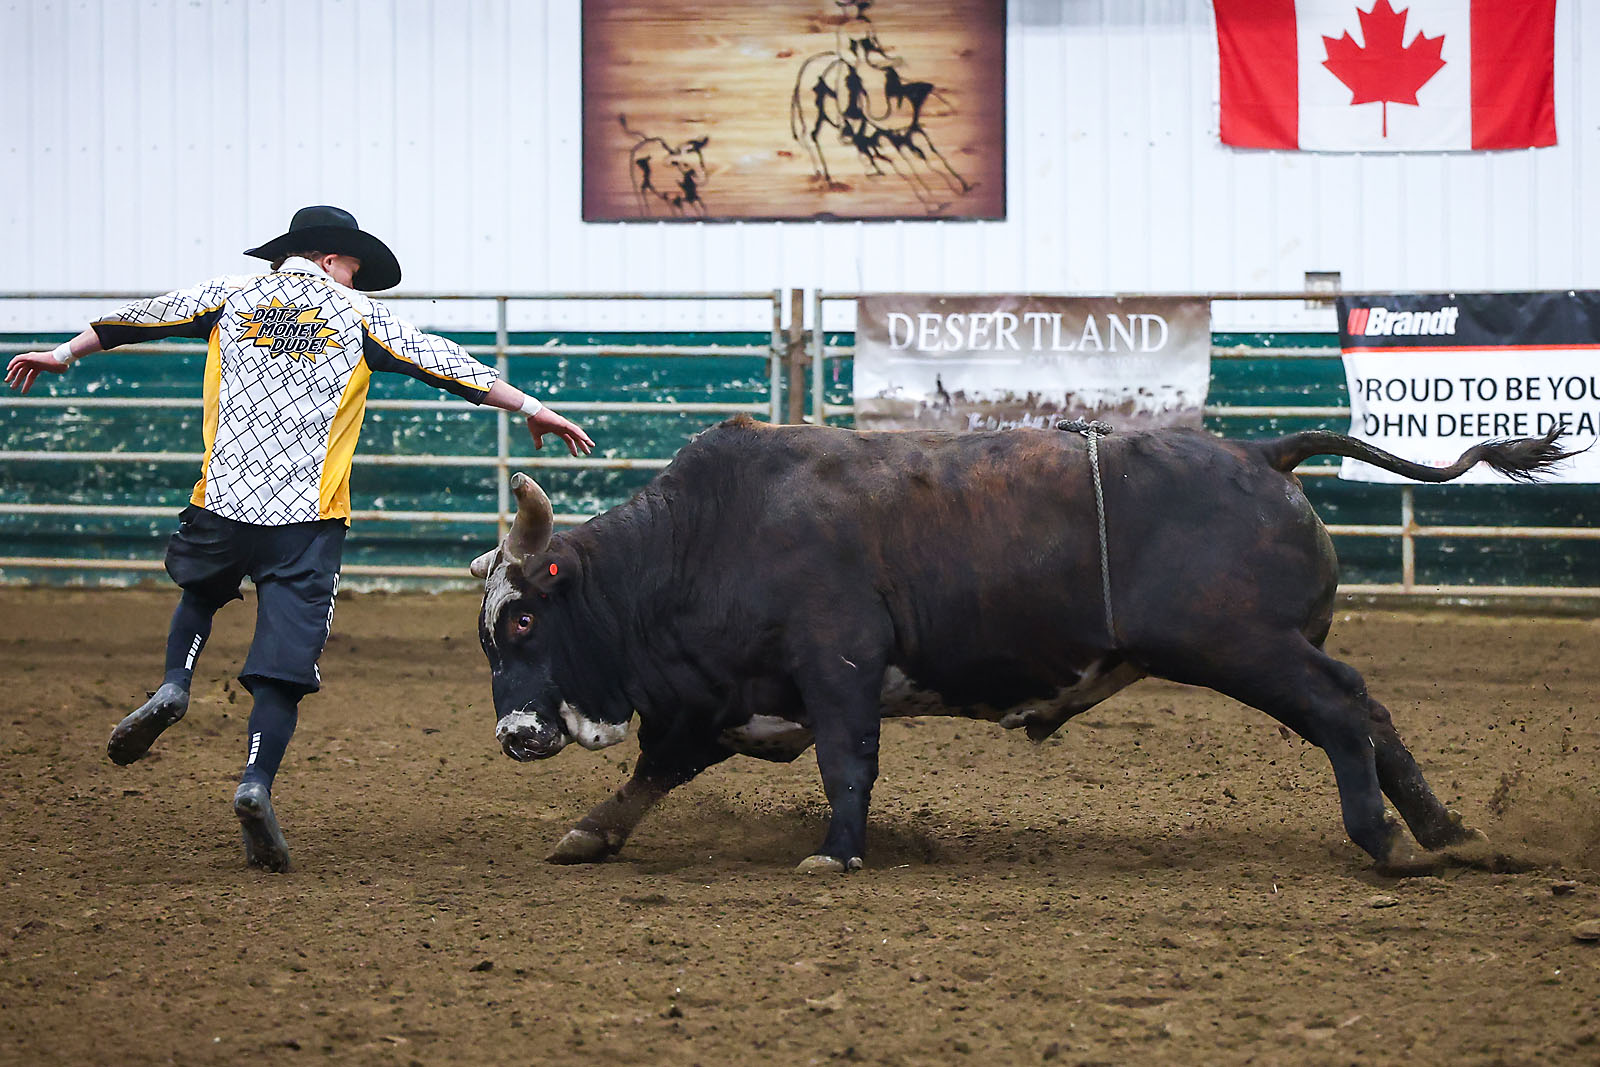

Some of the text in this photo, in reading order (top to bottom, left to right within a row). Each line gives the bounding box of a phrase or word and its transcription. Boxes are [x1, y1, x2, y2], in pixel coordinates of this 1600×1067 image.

[252, 308, 301, 322] DATZ
[1365, 306, 1459, 336] Brandt
[258, 323, 322, 337] MONEY
[887, 312, 1169, 353] DESERTLAND
[271, 338, 327, 353] DUDE!
[1459, 377, 1498, 402] TO
[1506, 377, 1541, 401] BE
[1362, 412, 1600, 437] OHN DEERE DEA
